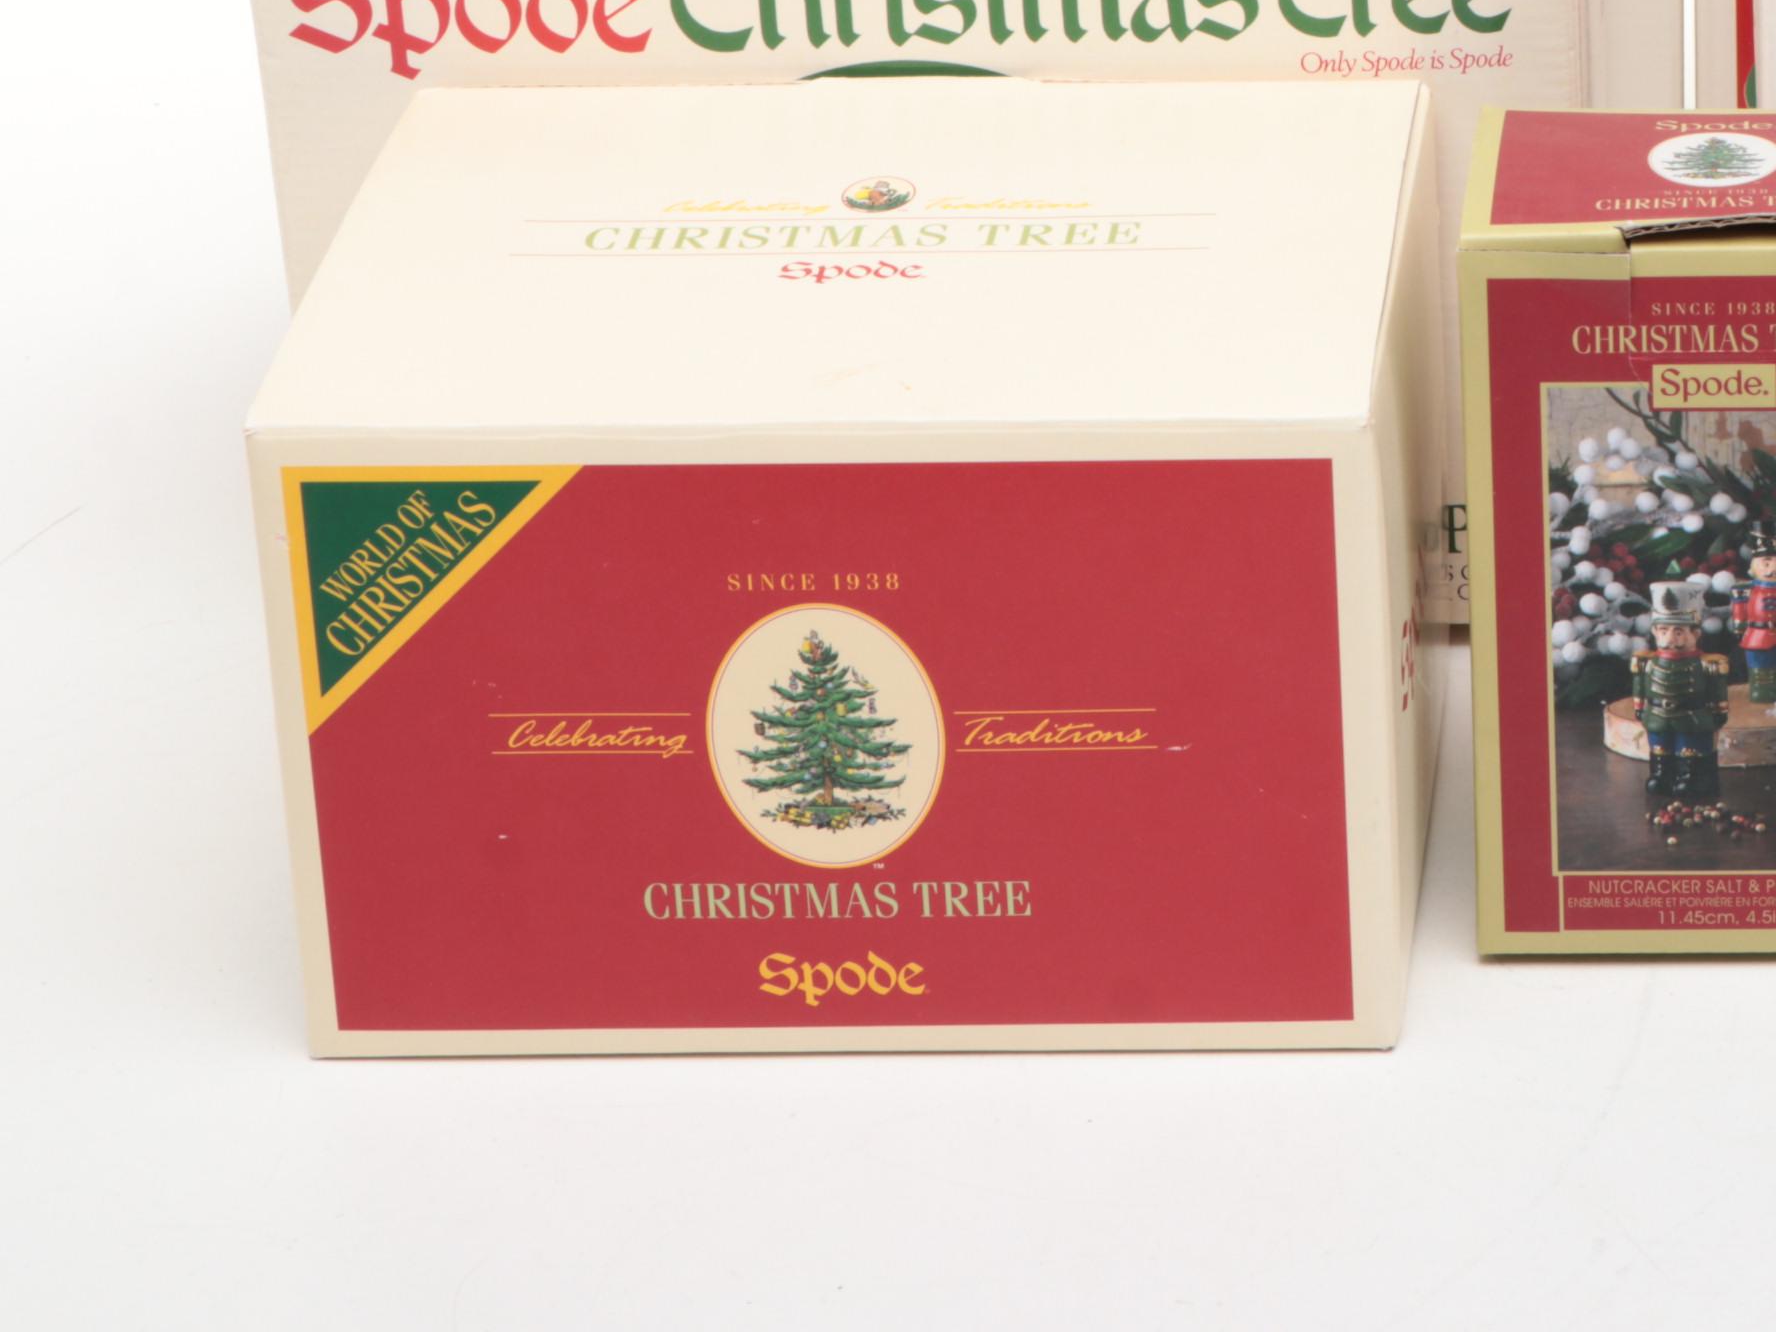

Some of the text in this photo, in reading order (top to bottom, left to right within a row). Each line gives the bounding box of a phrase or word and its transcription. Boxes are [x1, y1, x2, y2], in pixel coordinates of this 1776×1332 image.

[1301, 44, 1514, 78] Only Spode is Spode
[1594, 195, 1757, 211] CHRISTMAS
[584, 221, 1142, 251] CHRISTMAS TREE
[778, 260, 924, 285] Spode
[1651, 301, 1776, 316] SINCE 1938
[1571, 323, 1759, 354] CHRISTMAS
[320, 489, 435, 602] WORLD OF
[325, 490, 496, 656] CHRISTMAS
[726, 572, 900, 592] SINCE 1938
[508, 716, 1148, 759] Celebrating Traditions
[643, 880, 1032, 920] CHRISTMAS TREE
[1588, 878, 1702, 895] NUTCRACKER
[1705, 878, 1743, 895] SALT
[1748, 878, 1761, 894] &
[1567, 897, 1621, 908] ENSEMBLE
[1666, 897, 1677, 908] ET
[1735, 896, 1751, 907] EN
[758, 950, 926, 1007] Spode
